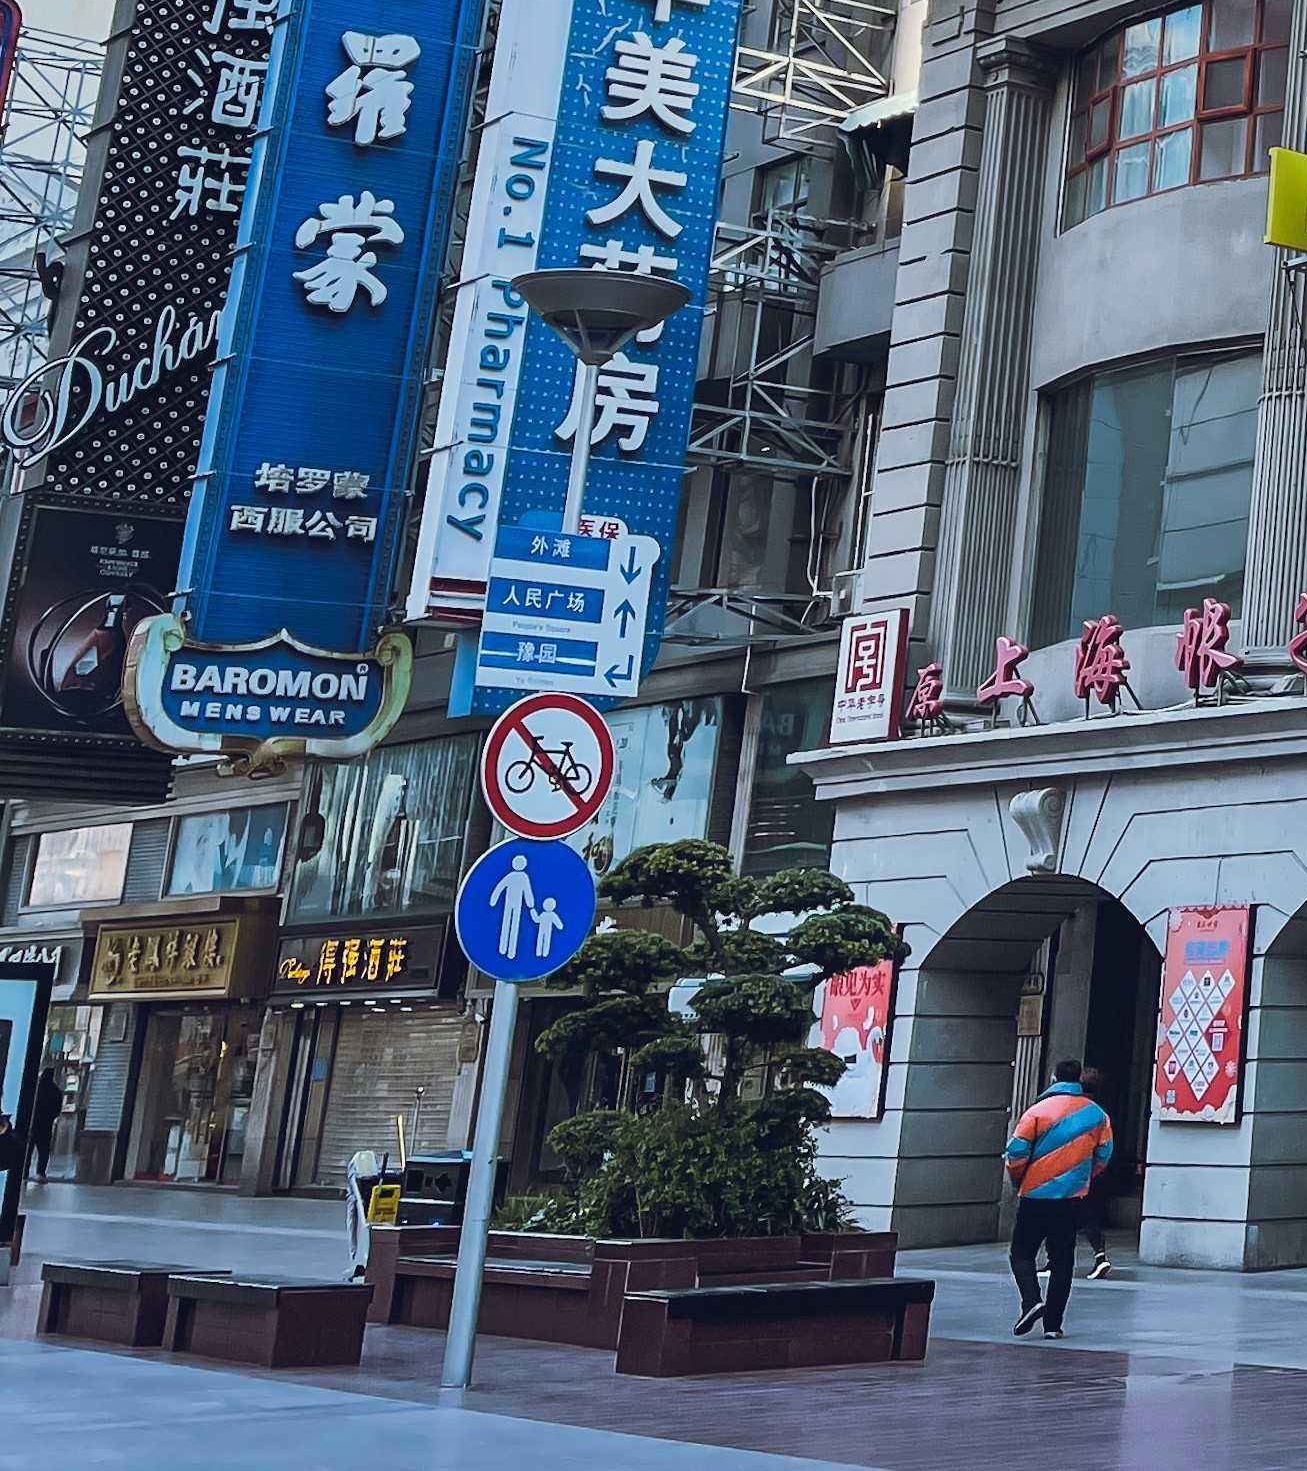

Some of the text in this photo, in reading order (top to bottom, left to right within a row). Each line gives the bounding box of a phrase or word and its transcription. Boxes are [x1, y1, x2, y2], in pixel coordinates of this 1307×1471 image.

[447, 136, 552, 542] No.1 Pharmacy
[253, 462, 373, 501] 培罗蒙
[229, 503, 379, 543] 西服公司
[530, 535, 571, 558] 外滩
[502, 585, 585, 614] 人民广场
[516, 640, 558, 664] 豫园
[170, 660, 368, 703] BAROMON
[180, 700, 347, 726] MENS WEAR
